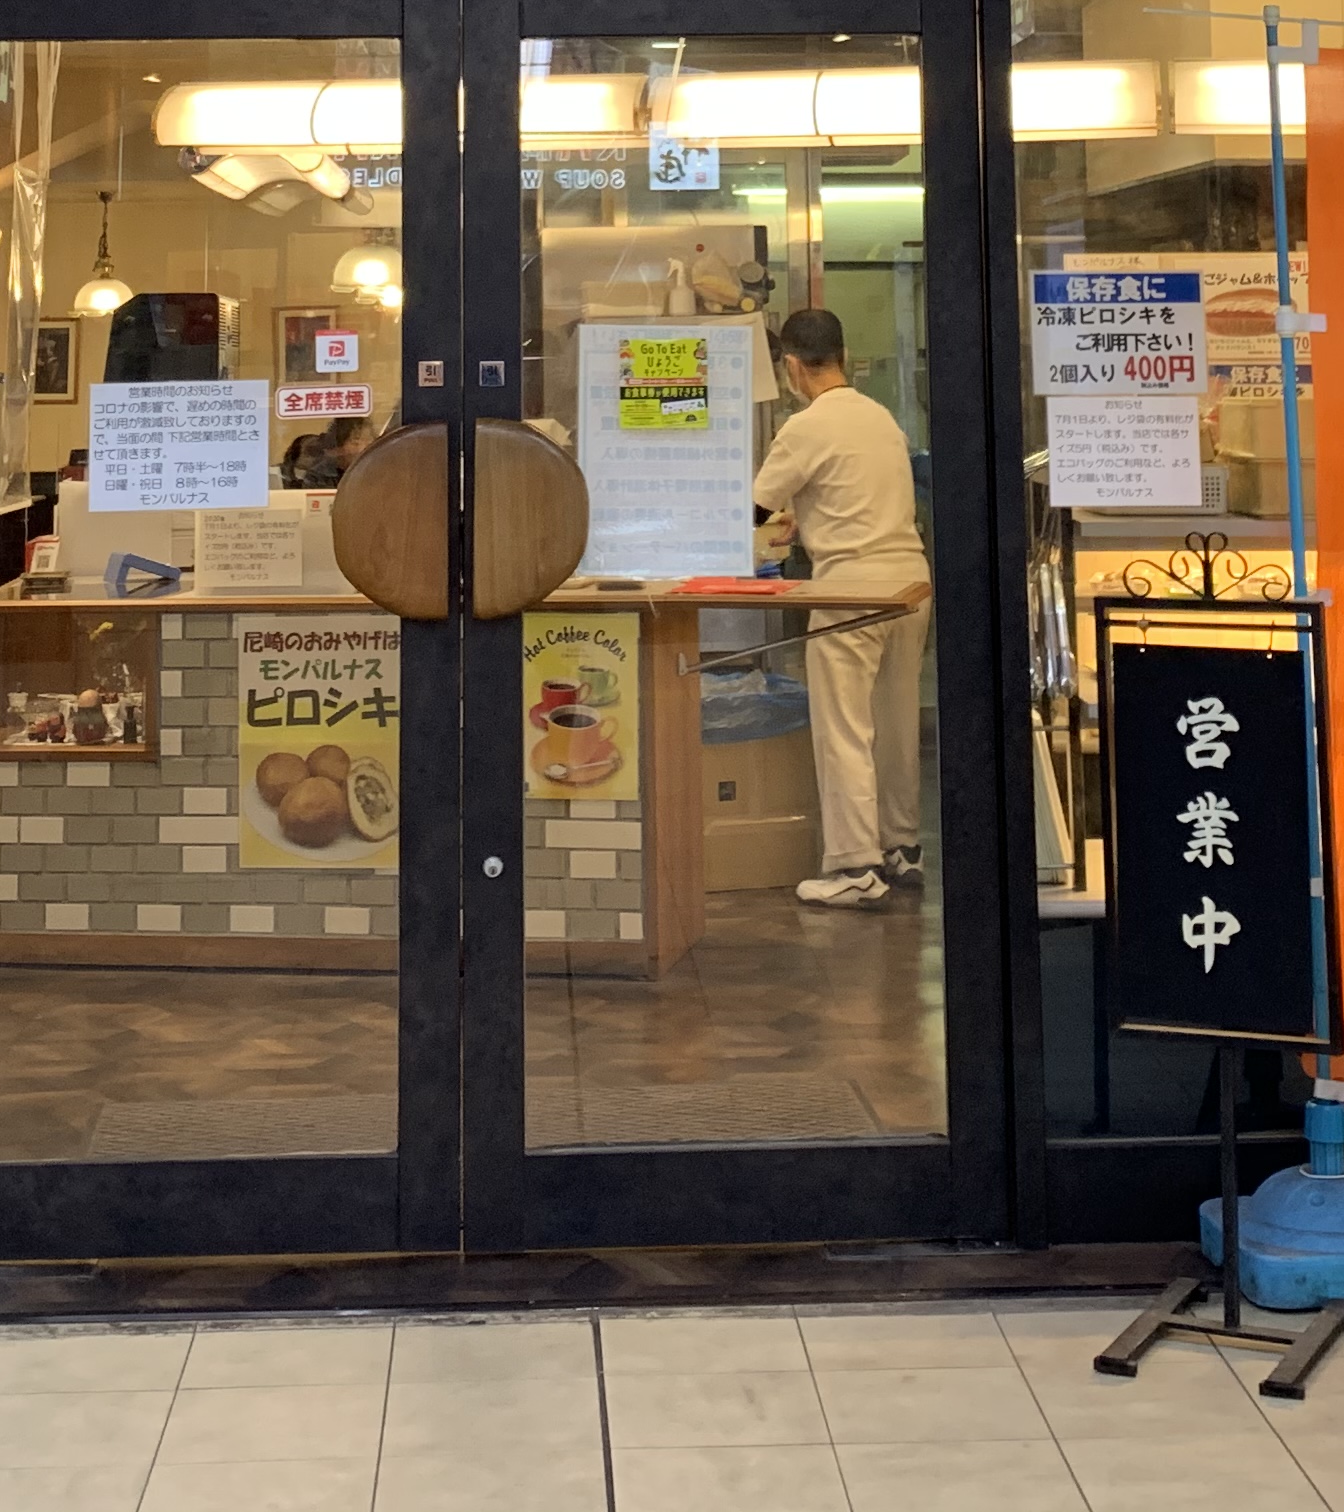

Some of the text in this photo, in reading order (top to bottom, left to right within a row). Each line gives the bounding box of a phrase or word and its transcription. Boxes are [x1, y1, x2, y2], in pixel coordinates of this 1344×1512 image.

[1065, 276, 1167, 303] 保存食に
[1036, 306, 1176, 327] 冷凍ピロシキを
[640, 342, 687, 355] Go To Eat
[323, 356, 351, 369] PayPay
[1049, 355, 1196, 384] 2個入り 400円
[128, 384, 234, 399] 営業時間のお知らせ
[283, 389, 367, 414] 全席禁煙
[1105, 400, 1143, 411] お知らせ
[93, 448, 168, 461] せて頂きます。
[104, 462, 164, 476] 平日・土曜
[104, 477, 163, 491] 日曜・祝日
[1096, 487, 1154, 498] モンパルナス
[139, 491, 210, 505] モンパルナス
[242, 630, 401, 654] 尼崎のおみやげは
[523, 627, 628, 664] Hot Coffee Color
[258, 658, 384, 681] モンパルナス
[246, 686, 400, 729] ピロシキ
[1175, 695, 1242, 975] 営業中
